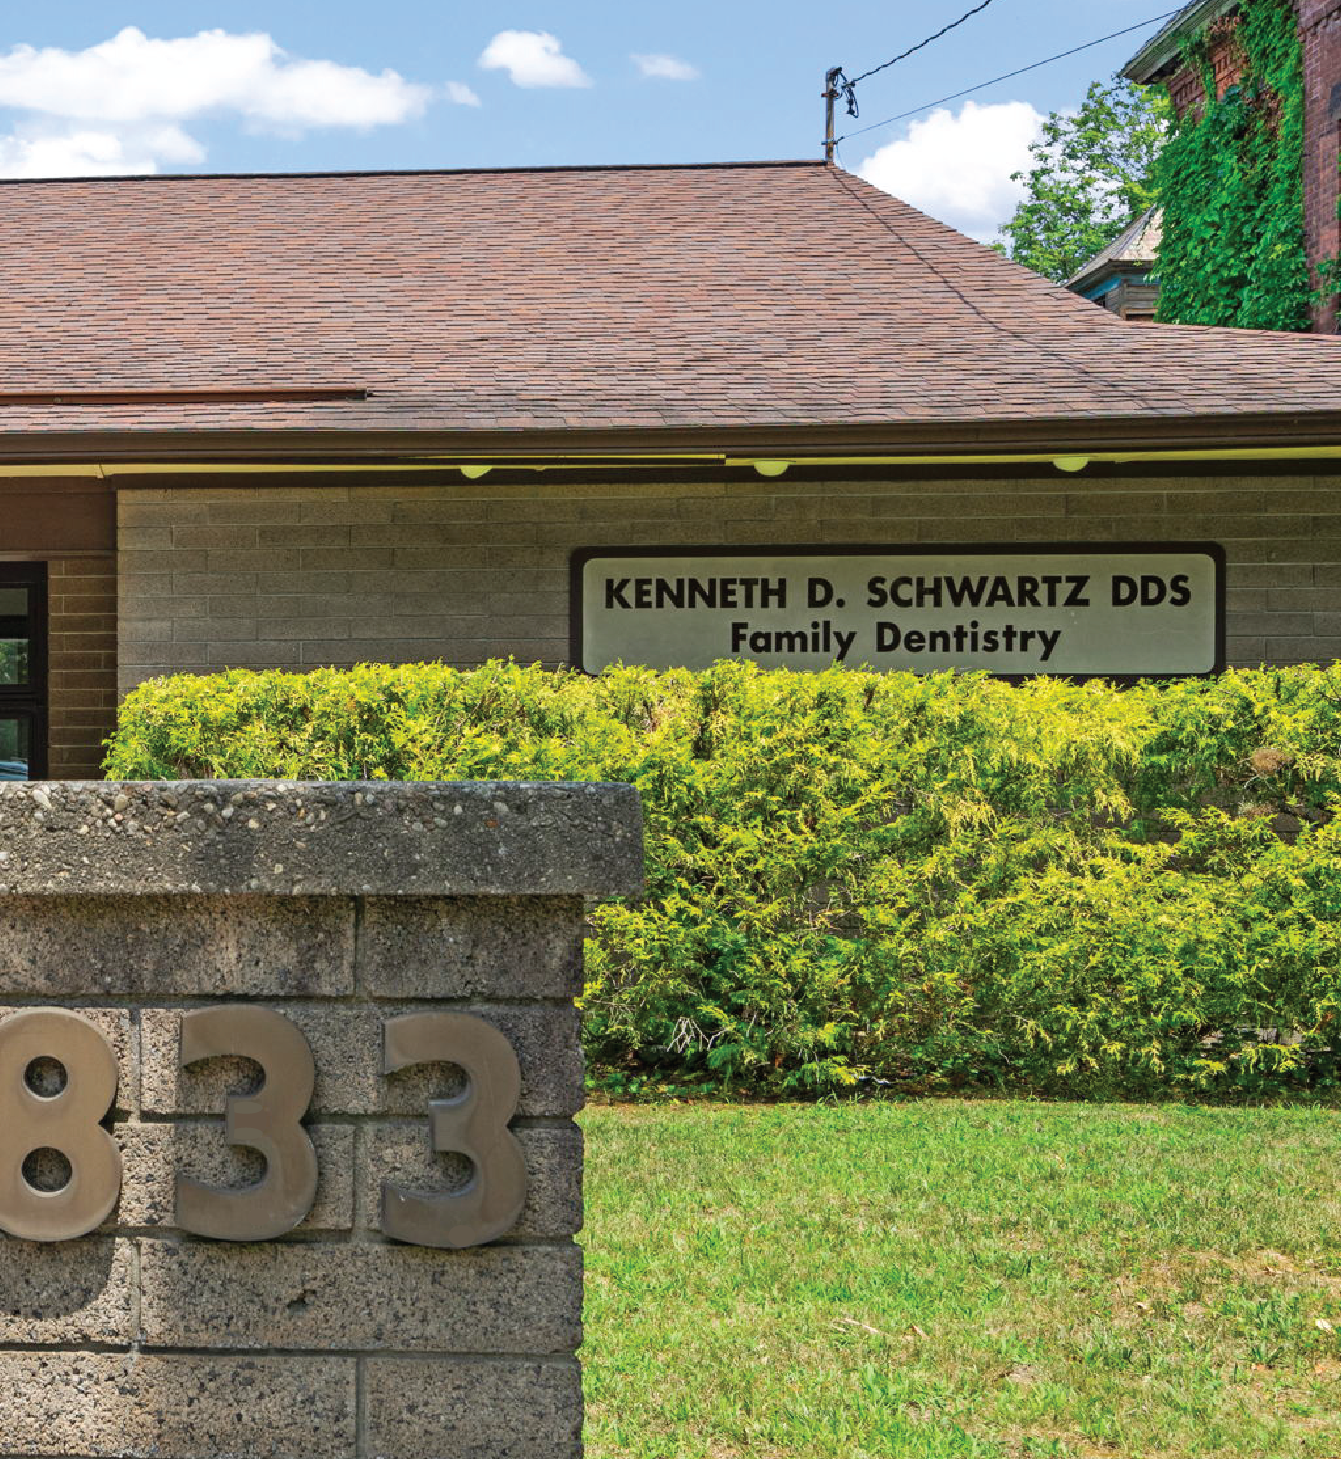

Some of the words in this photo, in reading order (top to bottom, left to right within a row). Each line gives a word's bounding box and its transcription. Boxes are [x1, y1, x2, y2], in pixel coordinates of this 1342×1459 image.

[605, 577, 787, 609] KENNETH
[807, 577, 845, 609] D.
[867, 575, 1091, 608] SCHWARTZ
[1111, 574, 1191, 607] DDS
[731, 620, 857, 662] Family
[875, 620, 1061, 662] Dentistry
